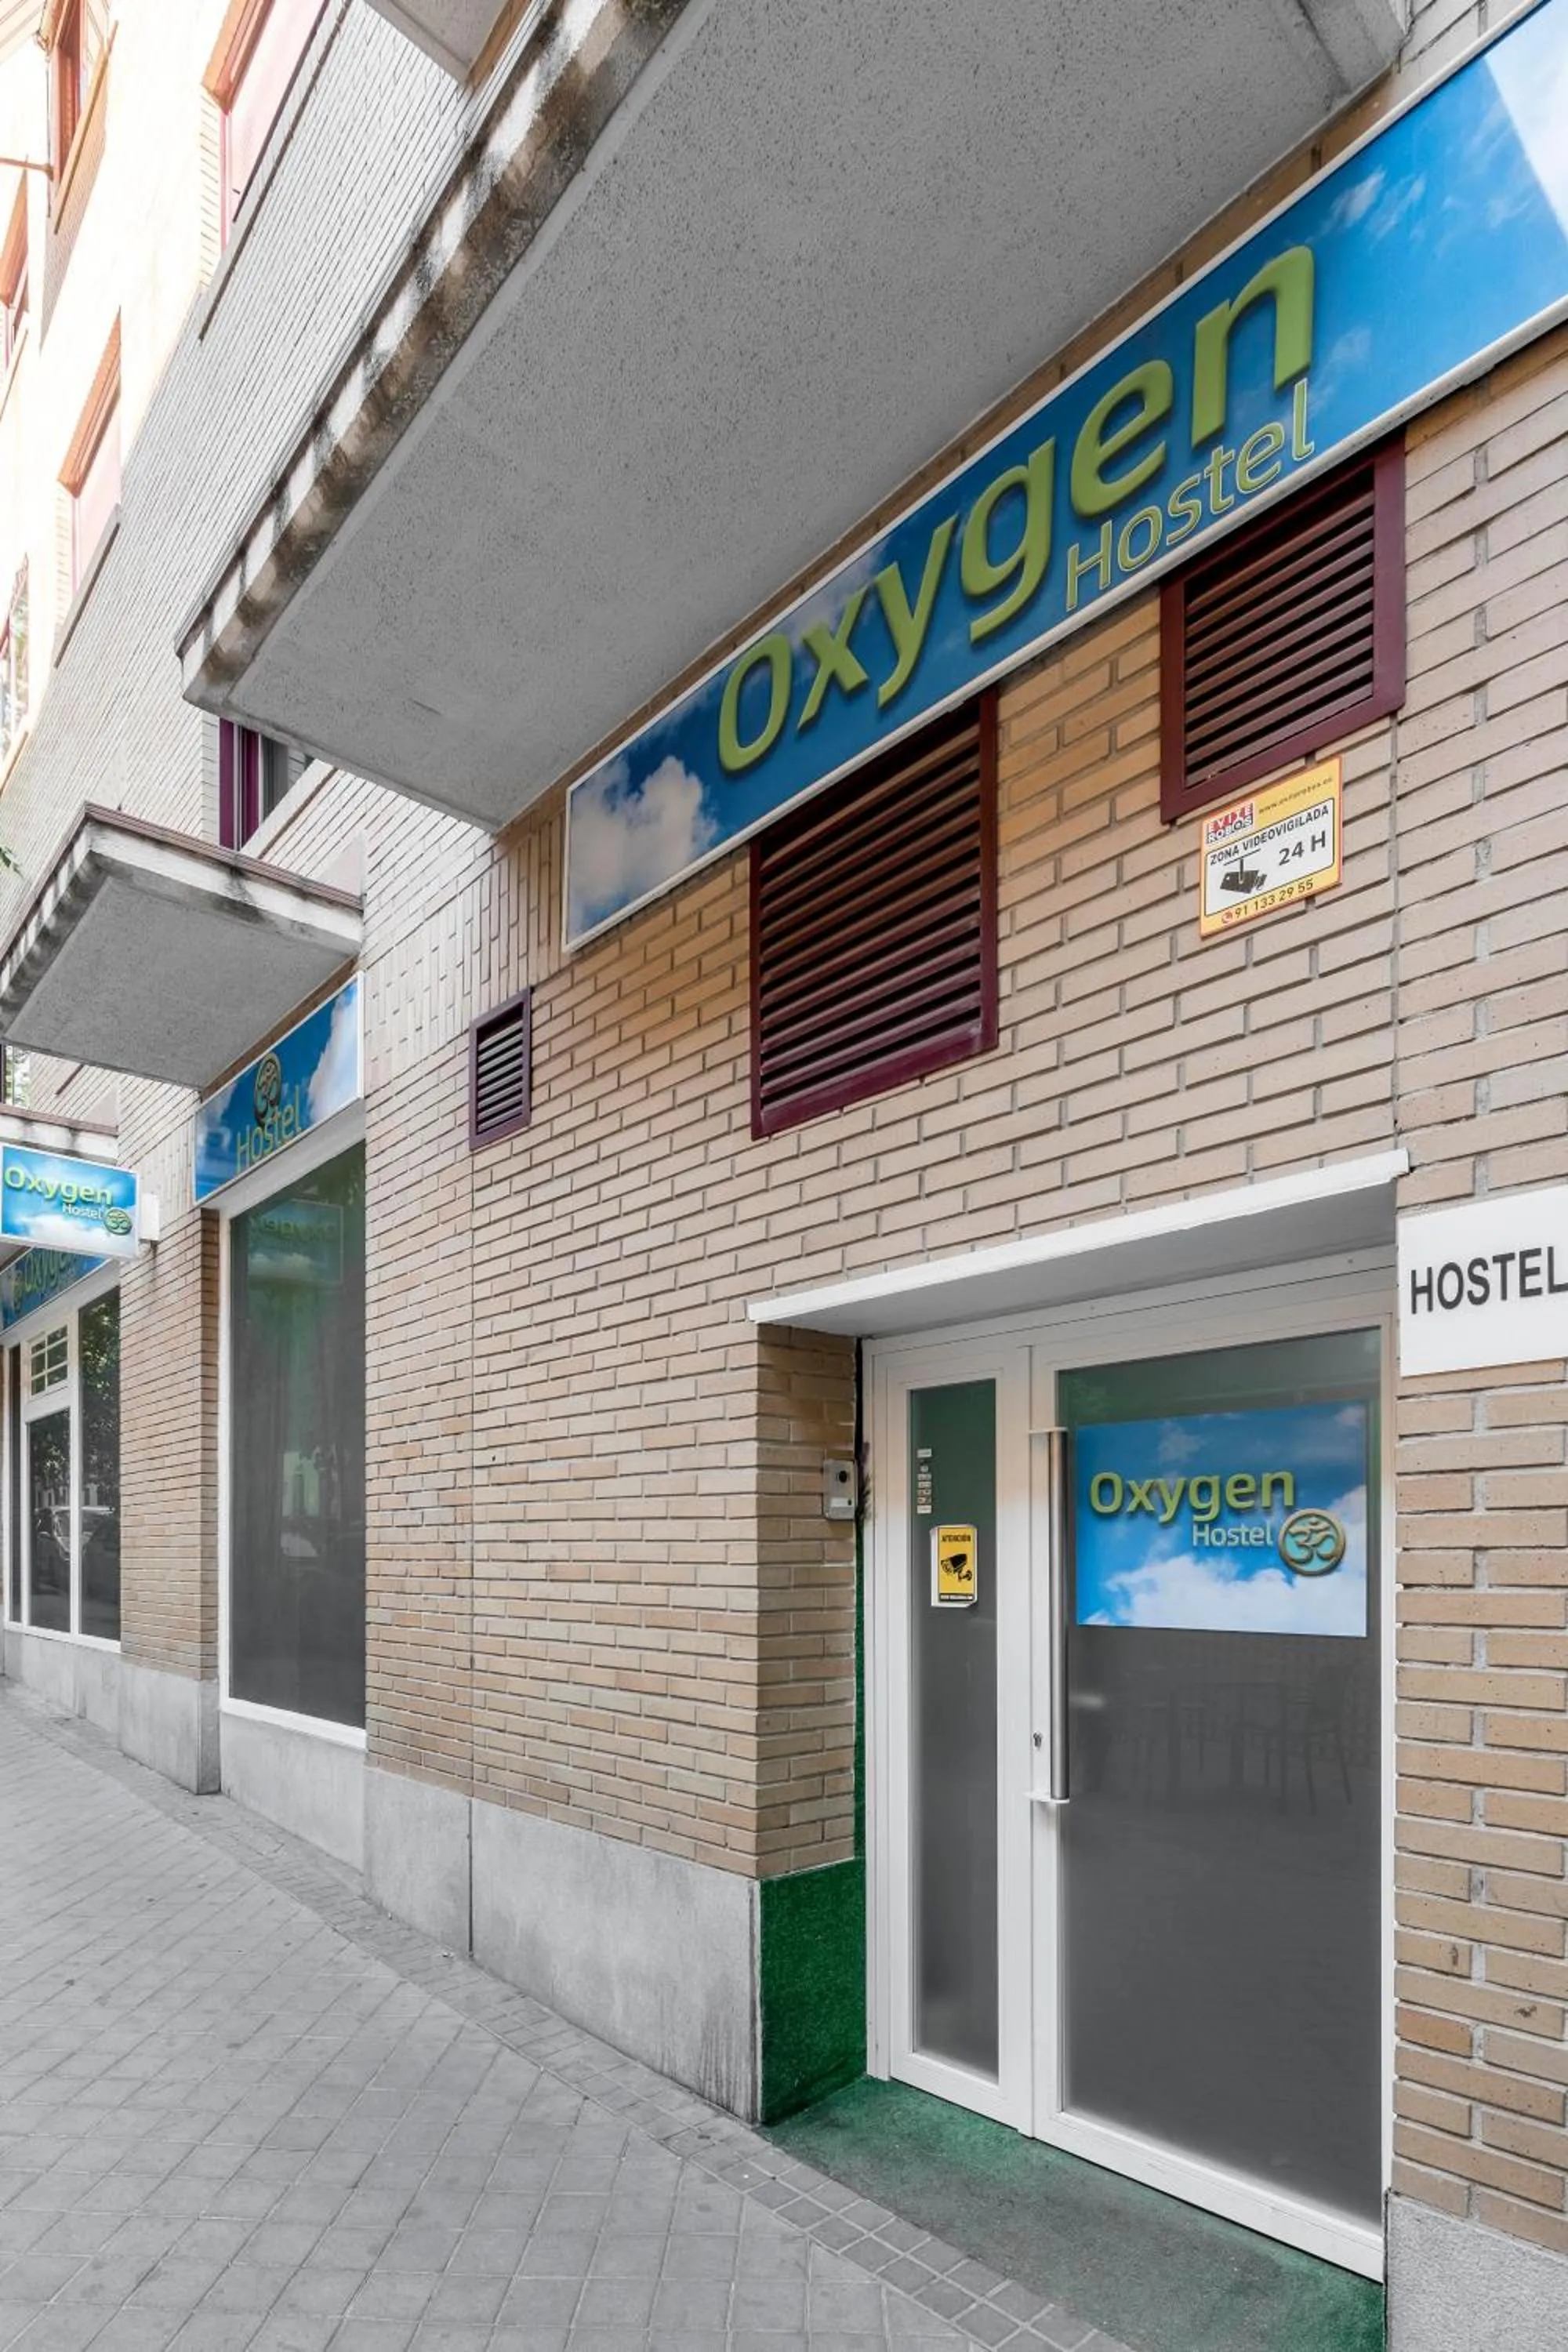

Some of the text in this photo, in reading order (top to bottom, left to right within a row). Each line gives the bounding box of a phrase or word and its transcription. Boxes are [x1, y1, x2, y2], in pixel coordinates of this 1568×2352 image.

[718, 245, 1315, 771] Oxygen
[1065, 378, 1315, 612] Hostel
[1210, 804, 1329, 866] ZONA VIDEOVIGILADA
[1279, 830, 1326, 866] 24 H
[1235, 879, 1314, 920] 91 133 29 55
[237, 1084, 302, 1174] Hostel
[4, 1166, 112, 1205] Oxygen
[62, 1203, 103, 1220] Hostel
[1411, 1246, 1568, 1314] HOSTEL
[1091, 1471, 1294, 1523] Oxygen
[1192, 1523, 1274, 1547] Hostel
